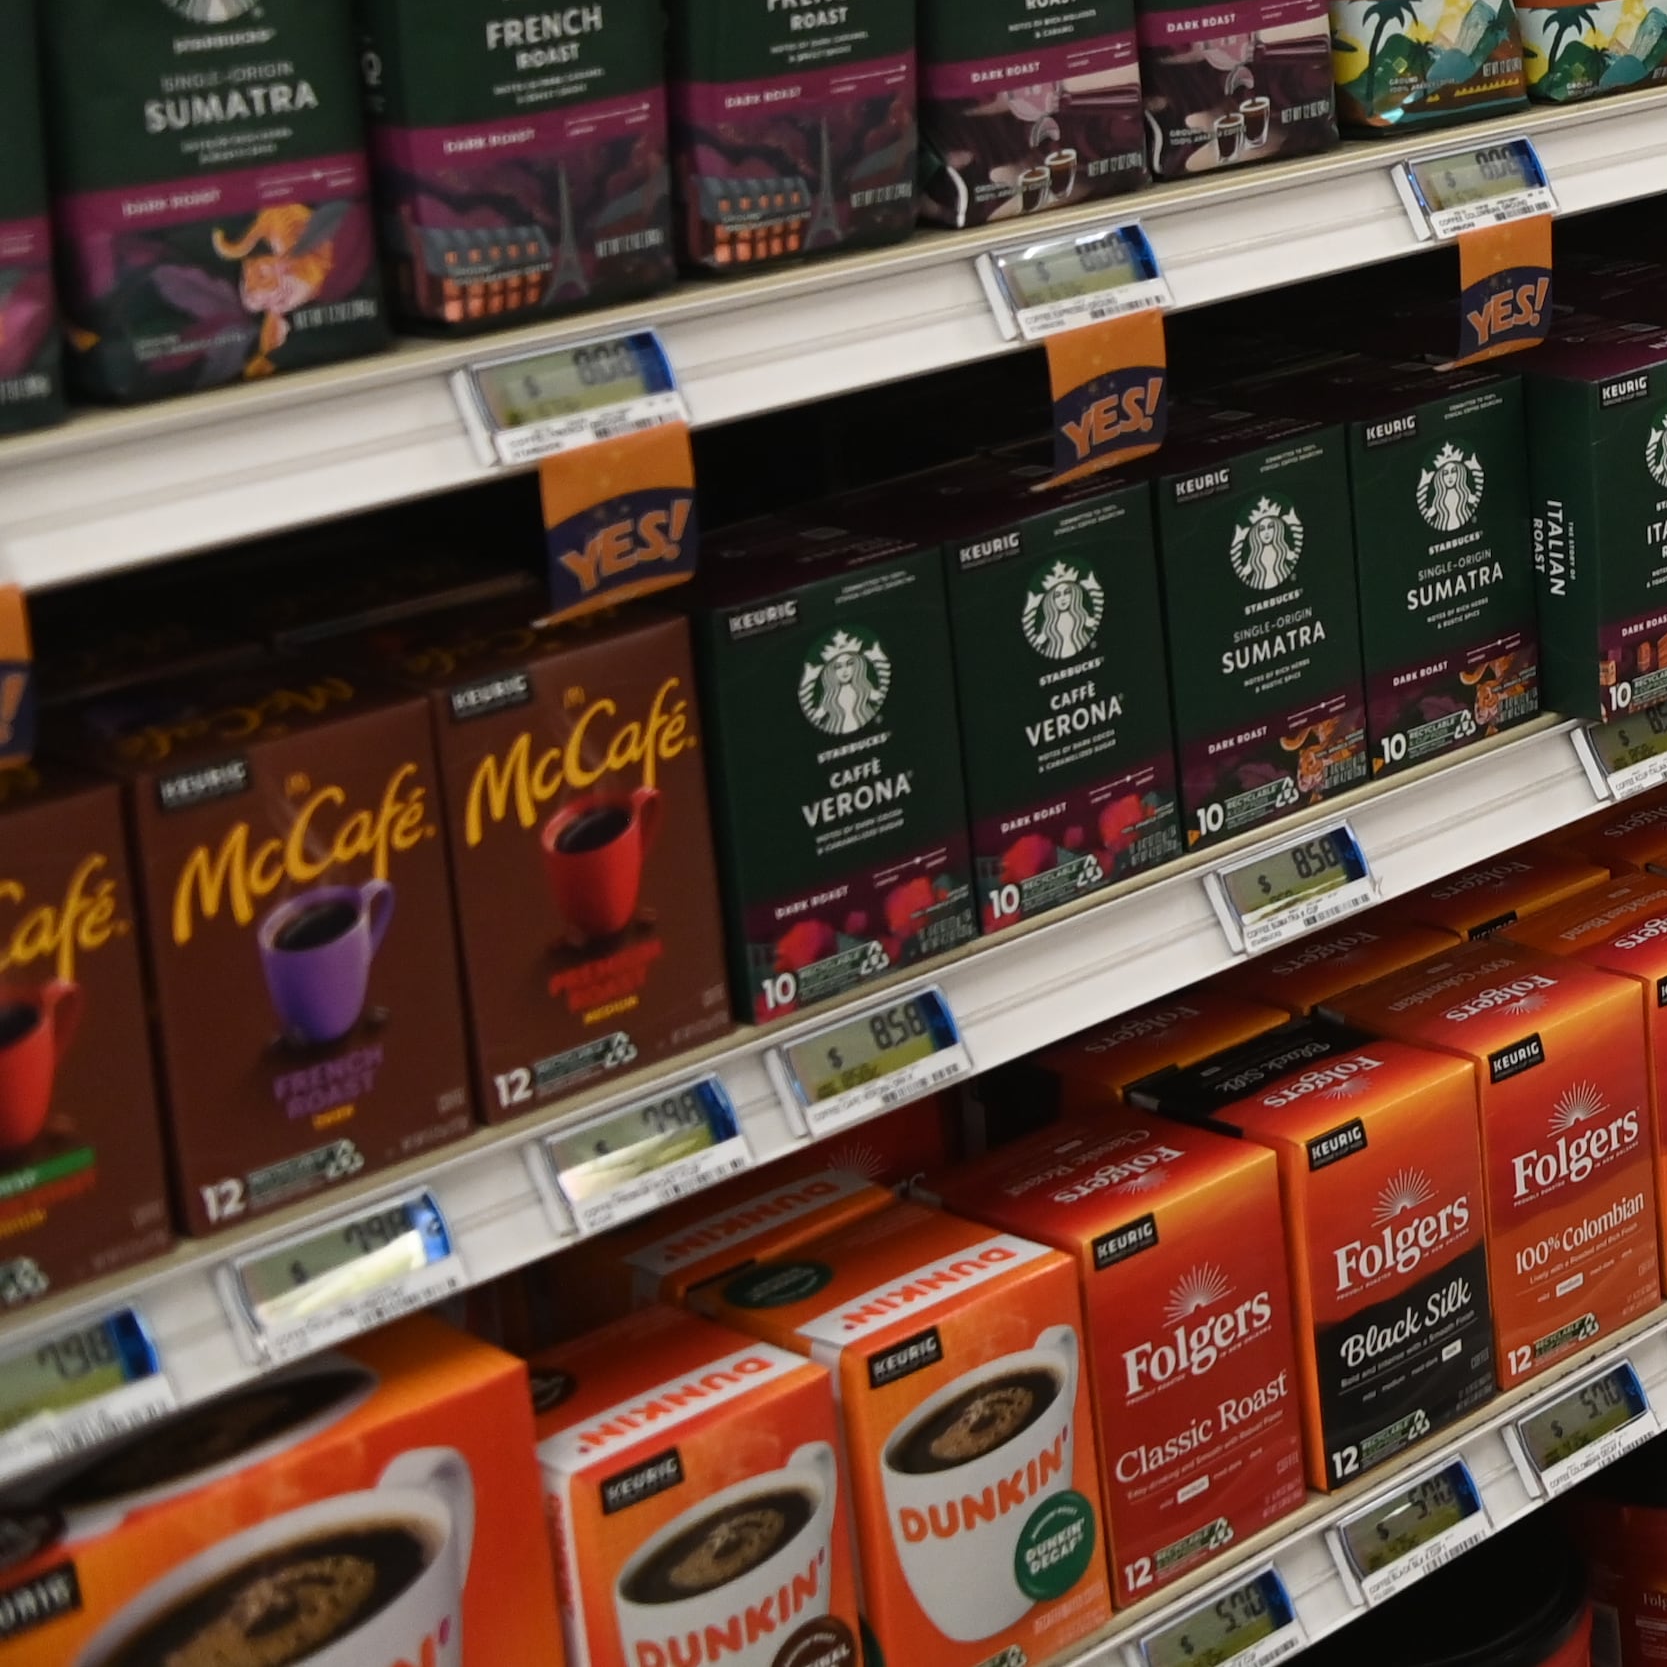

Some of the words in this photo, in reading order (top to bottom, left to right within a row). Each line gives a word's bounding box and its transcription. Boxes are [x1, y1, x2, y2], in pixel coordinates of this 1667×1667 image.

[485, 5, 603, 51] FRENCH
[790, 6, 848, 32] ROAST
[144, 81, 318, 132] SUMATRA
[1466, 276, 1550, 345] YES!
[1602, 376, 1648, 400] KEURIG
[1062, 375, 1164, 459] YES!
[561, 498, 692, 592] YES!
[1406, 562, 1503, 612] SUMATRA
[1221, 620, 1326, 675] SUMATRA
[1233, 606, 1313, 643] SINGLE-ORIGIN
[1026, 694, 1121, 747] VERONA
[1050, 681, 1096, 712] CAFFÈ
[465, 675, 689, 848] McCafé
[801, 773, 909, 829] VERONA
[1197, 802, 1225, 835] 10
[173, 761, 426, 946] McCafé
[1309, 1124, 1363, 1162] KEURIG
[1097, 1220, 1155, 1260] KEURIG
[1334, 1197, 1470, 1292] Folgers
[1122, 1290, 1272, 1396] Folgers
[1340, 1304, 1421, 1368] Black
[1424, 1276, 1472, 1323] Silk
[1116, 1418, 1215, 1484] Classic
[1218, 1369, 1288, 1433] Roast
[898, 1425, 1069, 1545] DUNKIN'
[1331, 1444, 1360, 1480] 12
[1124, 1559, 1154, 1592] 12
